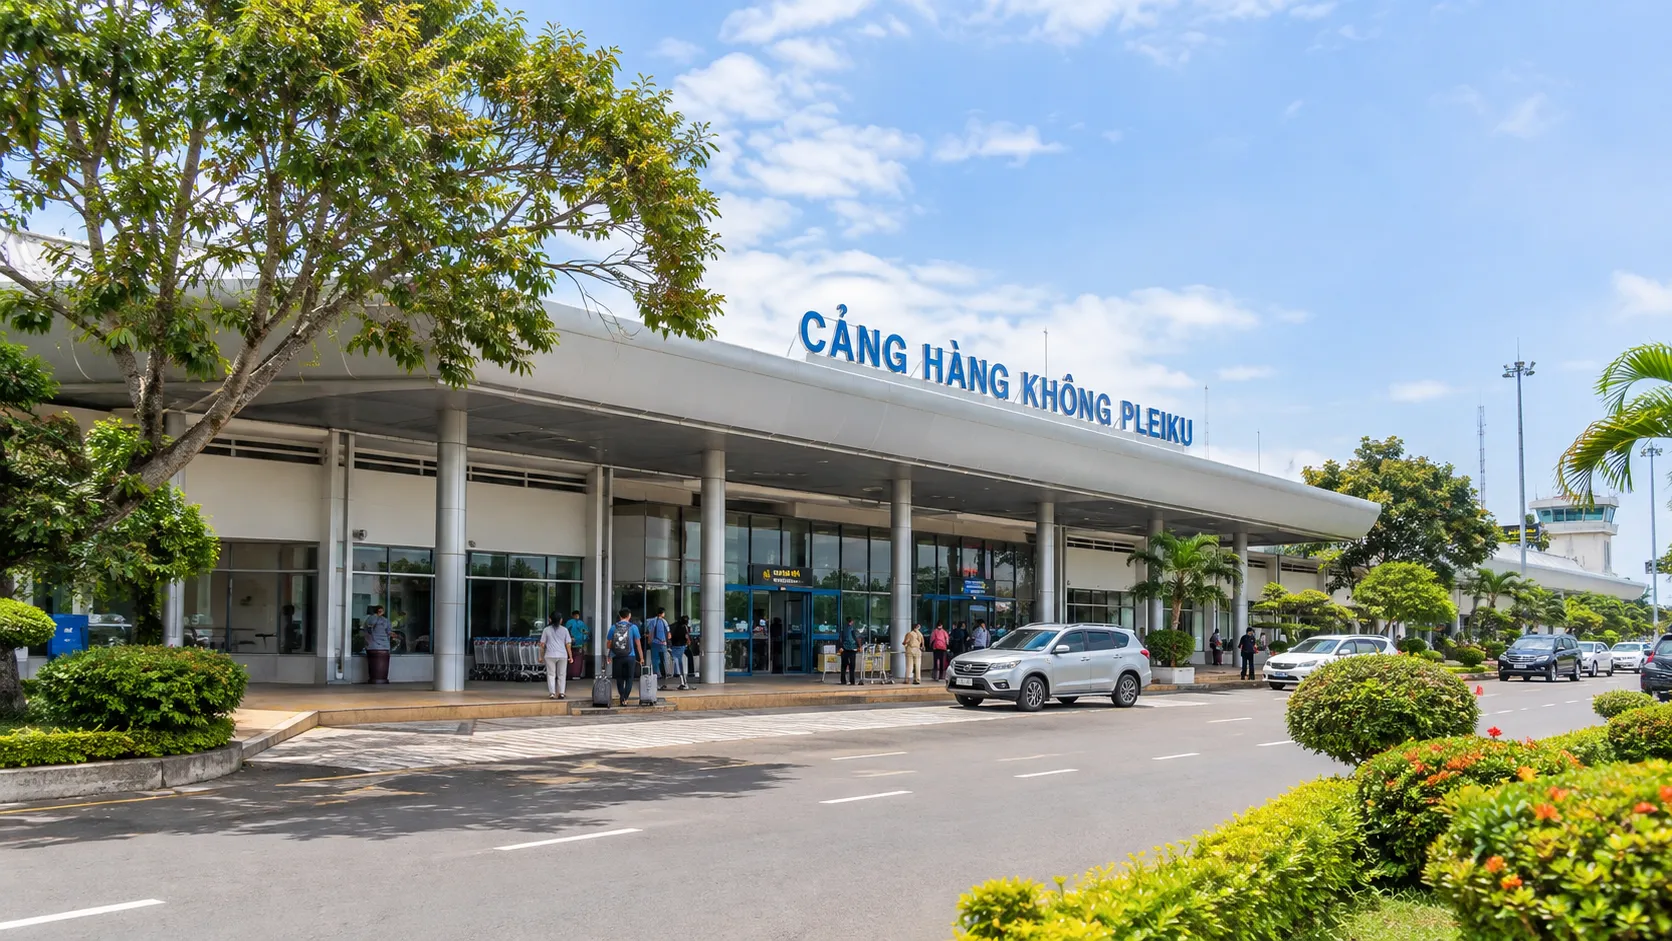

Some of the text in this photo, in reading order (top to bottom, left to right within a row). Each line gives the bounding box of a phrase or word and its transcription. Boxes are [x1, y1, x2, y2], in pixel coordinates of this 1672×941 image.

[799, 303, 1193, 447] CẢNG HÀNG KHÔNG PLEIKU
